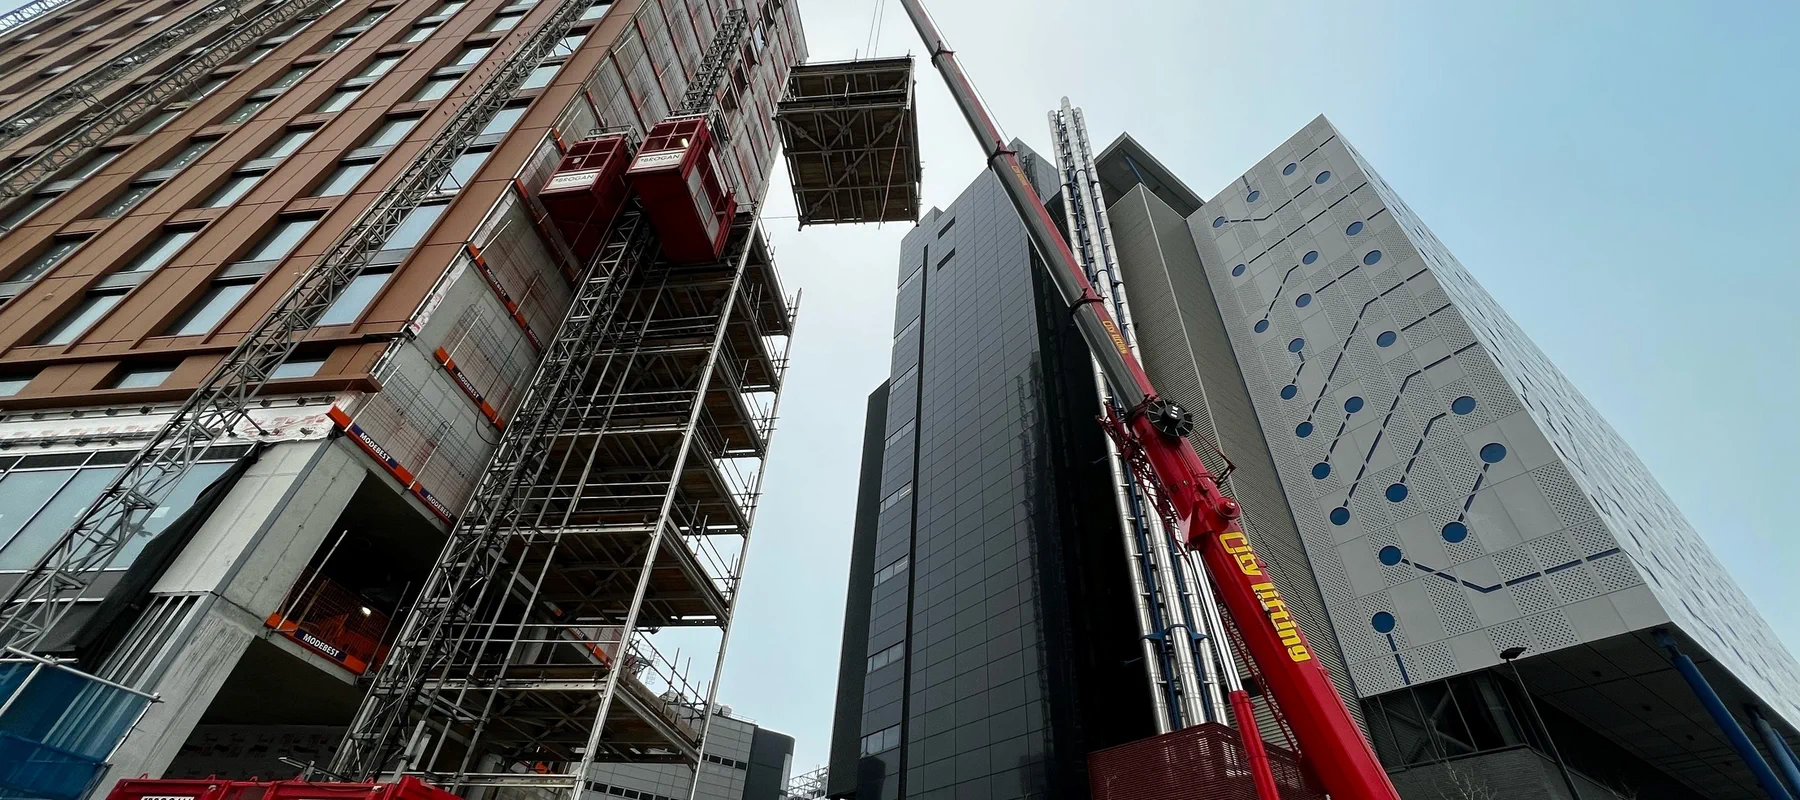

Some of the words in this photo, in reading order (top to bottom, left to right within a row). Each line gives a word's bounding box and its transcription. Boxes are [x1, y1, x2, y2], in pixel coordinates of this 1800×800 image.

[457, 372, 480, 399] MODEBEST
[359, 432, 391, 462] MODEBEST
[426, 494, 452, 519] MODEBEST
[1219, 532, 1262, 576] City
[1251, 582, 1312, 662] lifting
[302, 633, 340, 657] MODEBEST
